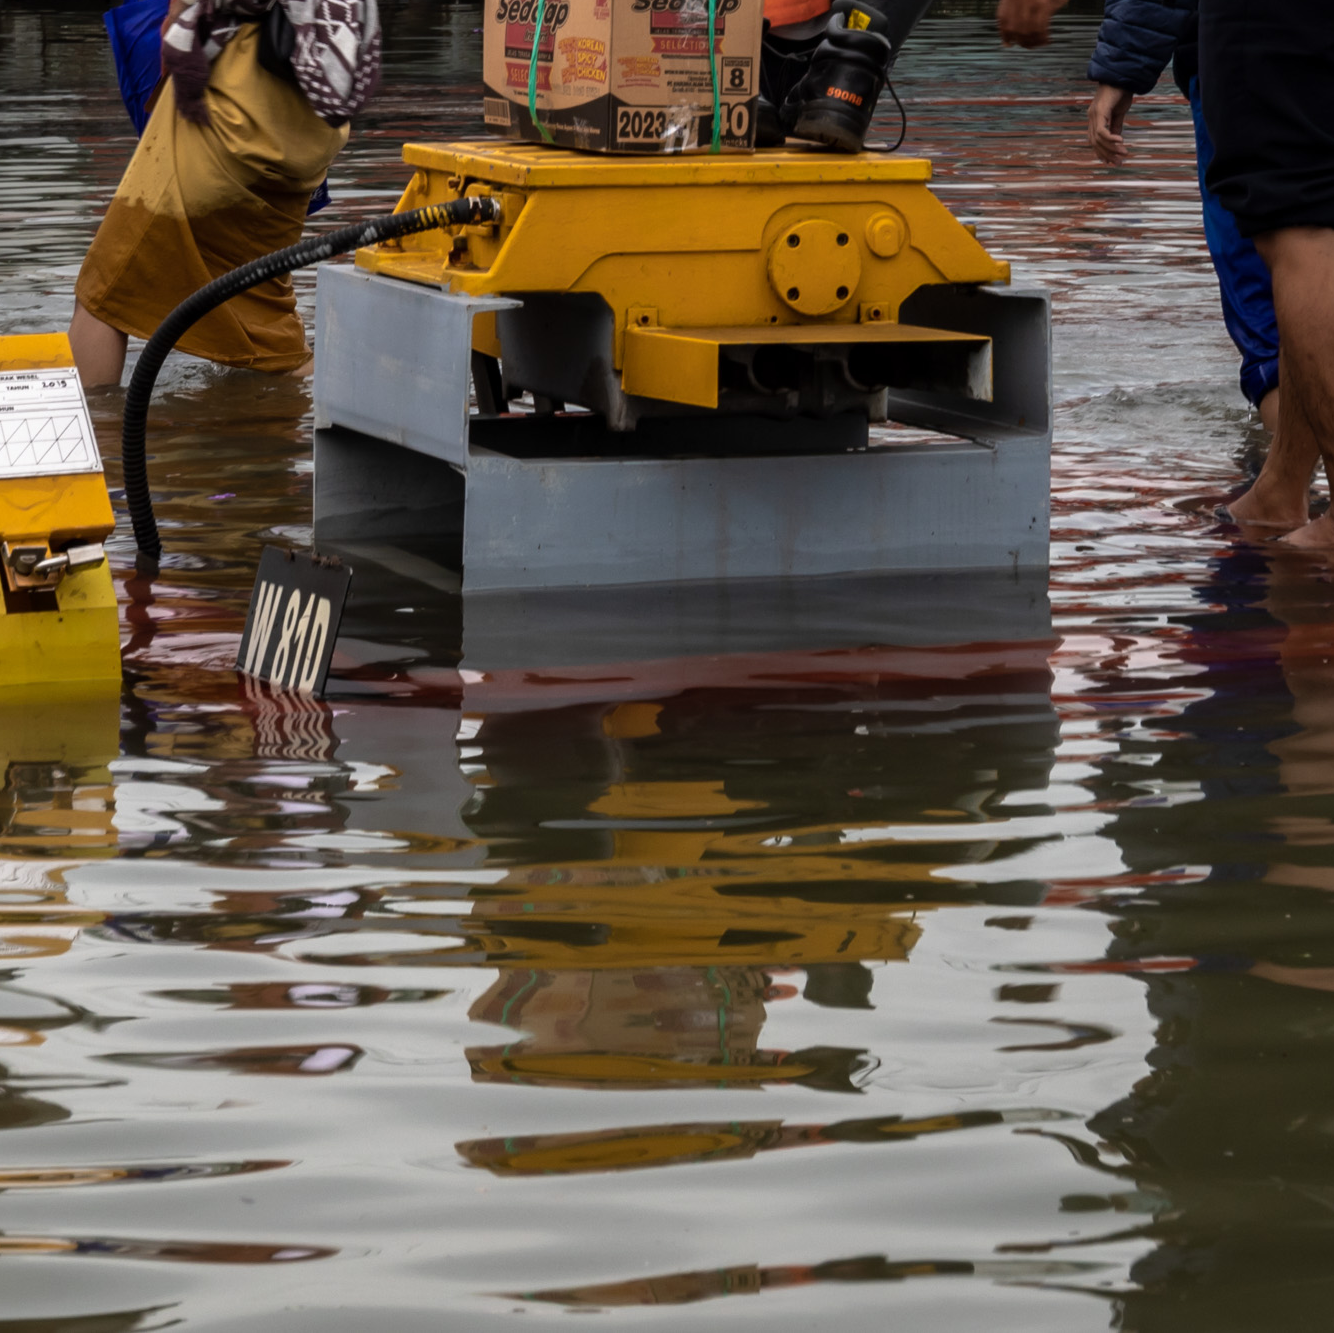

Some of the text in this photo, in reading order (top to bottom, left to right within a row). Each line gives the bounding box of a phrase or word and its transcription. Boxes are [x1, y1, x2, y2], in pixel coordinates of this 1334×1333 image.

[578, 38, 604, 53] KOREAN
[577, 52, 597, 65] SPICY
[577, 66, 605, 81] CHICKEN
[729, 68, 745, 87] 8
[244, 580, 283, 678] W
